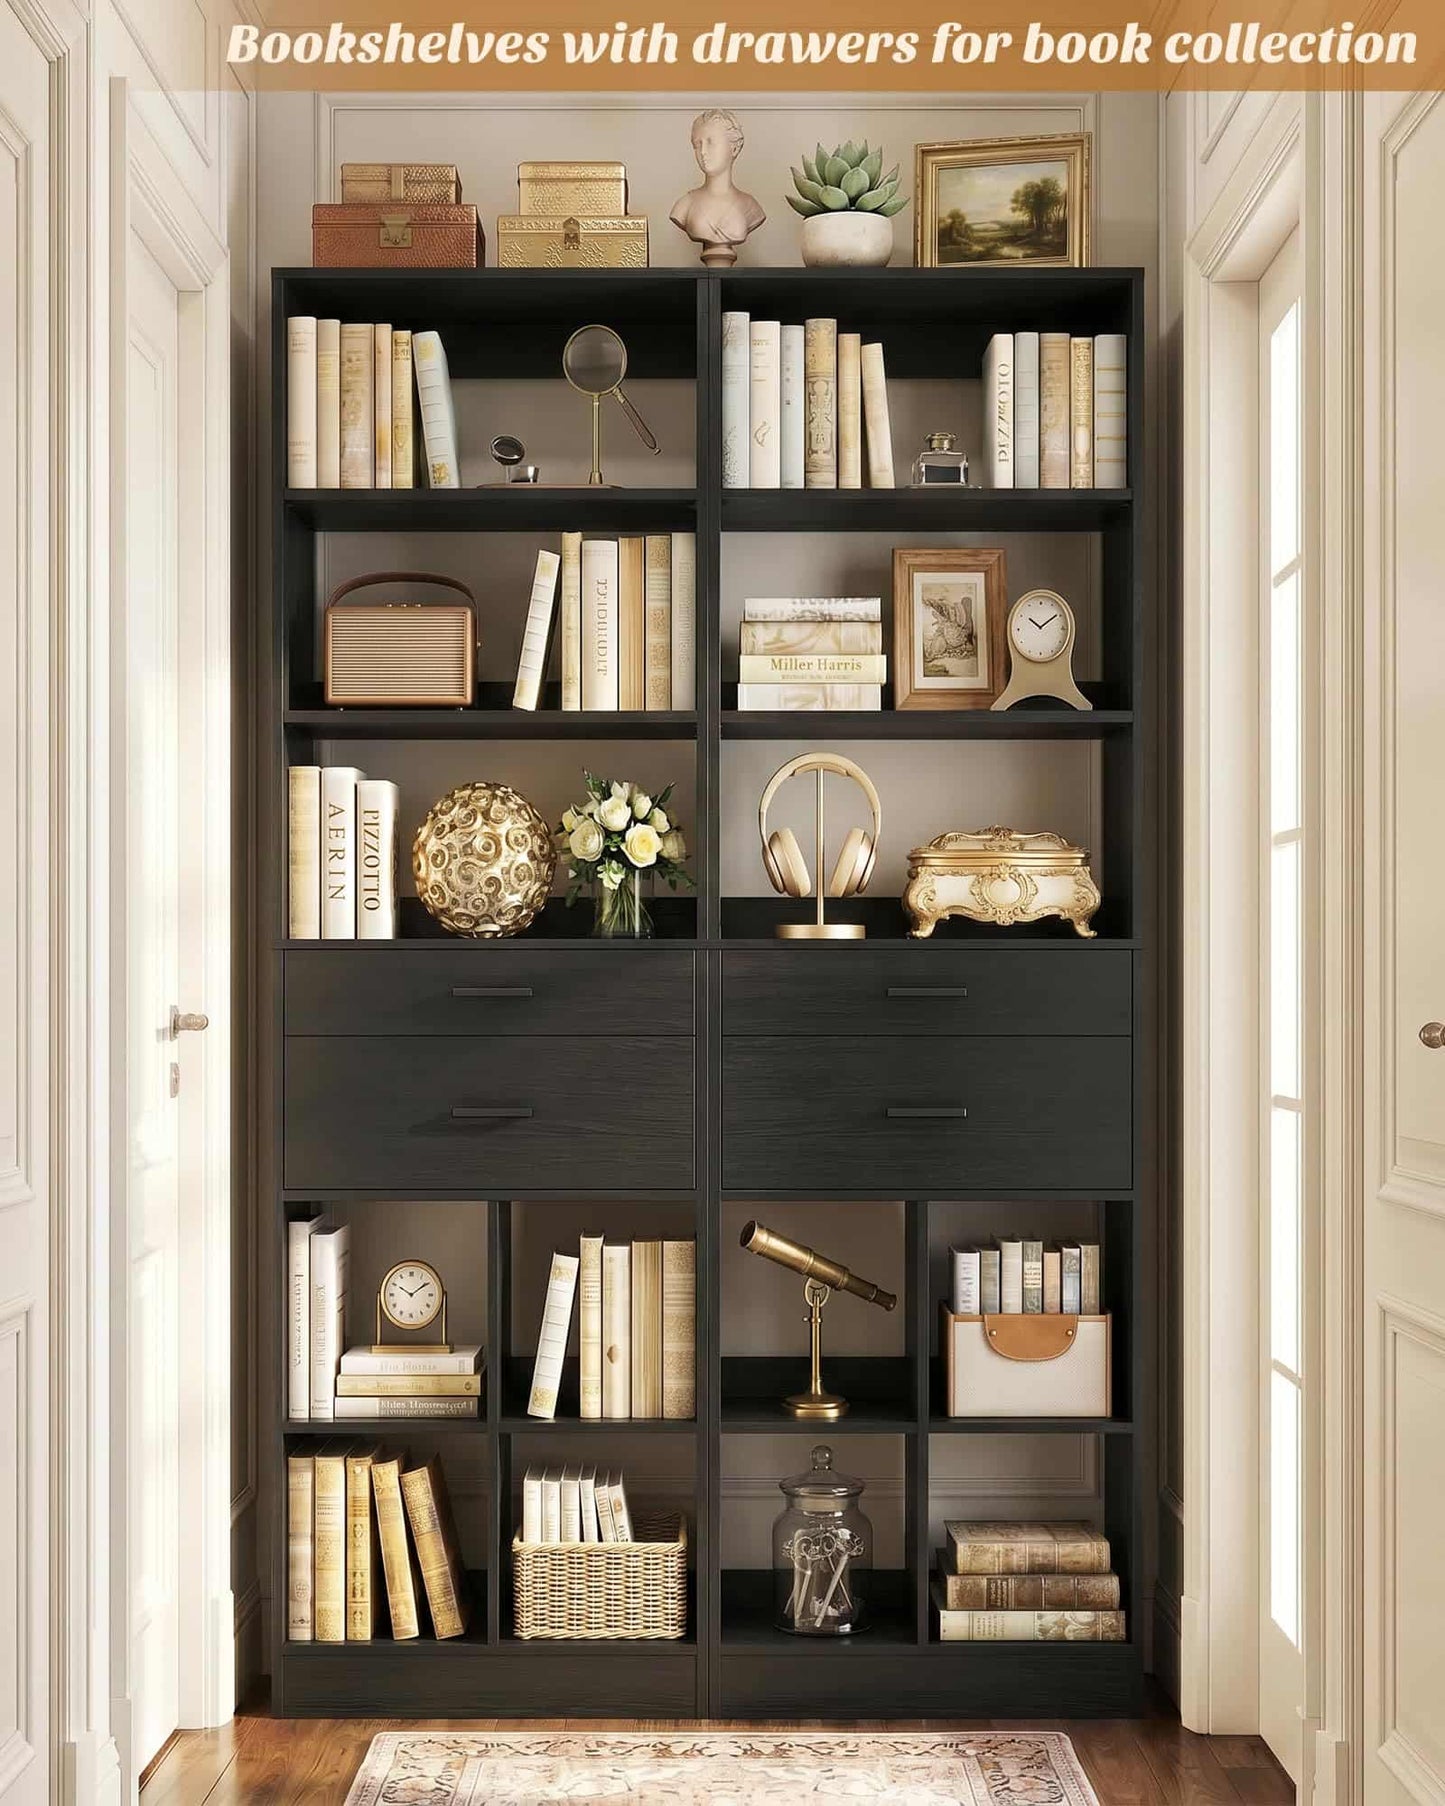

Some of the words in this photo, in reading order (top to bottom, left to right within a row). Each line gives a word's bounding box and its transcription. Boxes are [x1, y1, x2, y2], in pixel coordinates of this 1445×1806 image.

[771, 657, 813, 671] Miller
[818, 657, 862, 671] Harris
[328, 803, 346, 900] AERIN
[363, 809, 381, 911] PIZZOTTO
